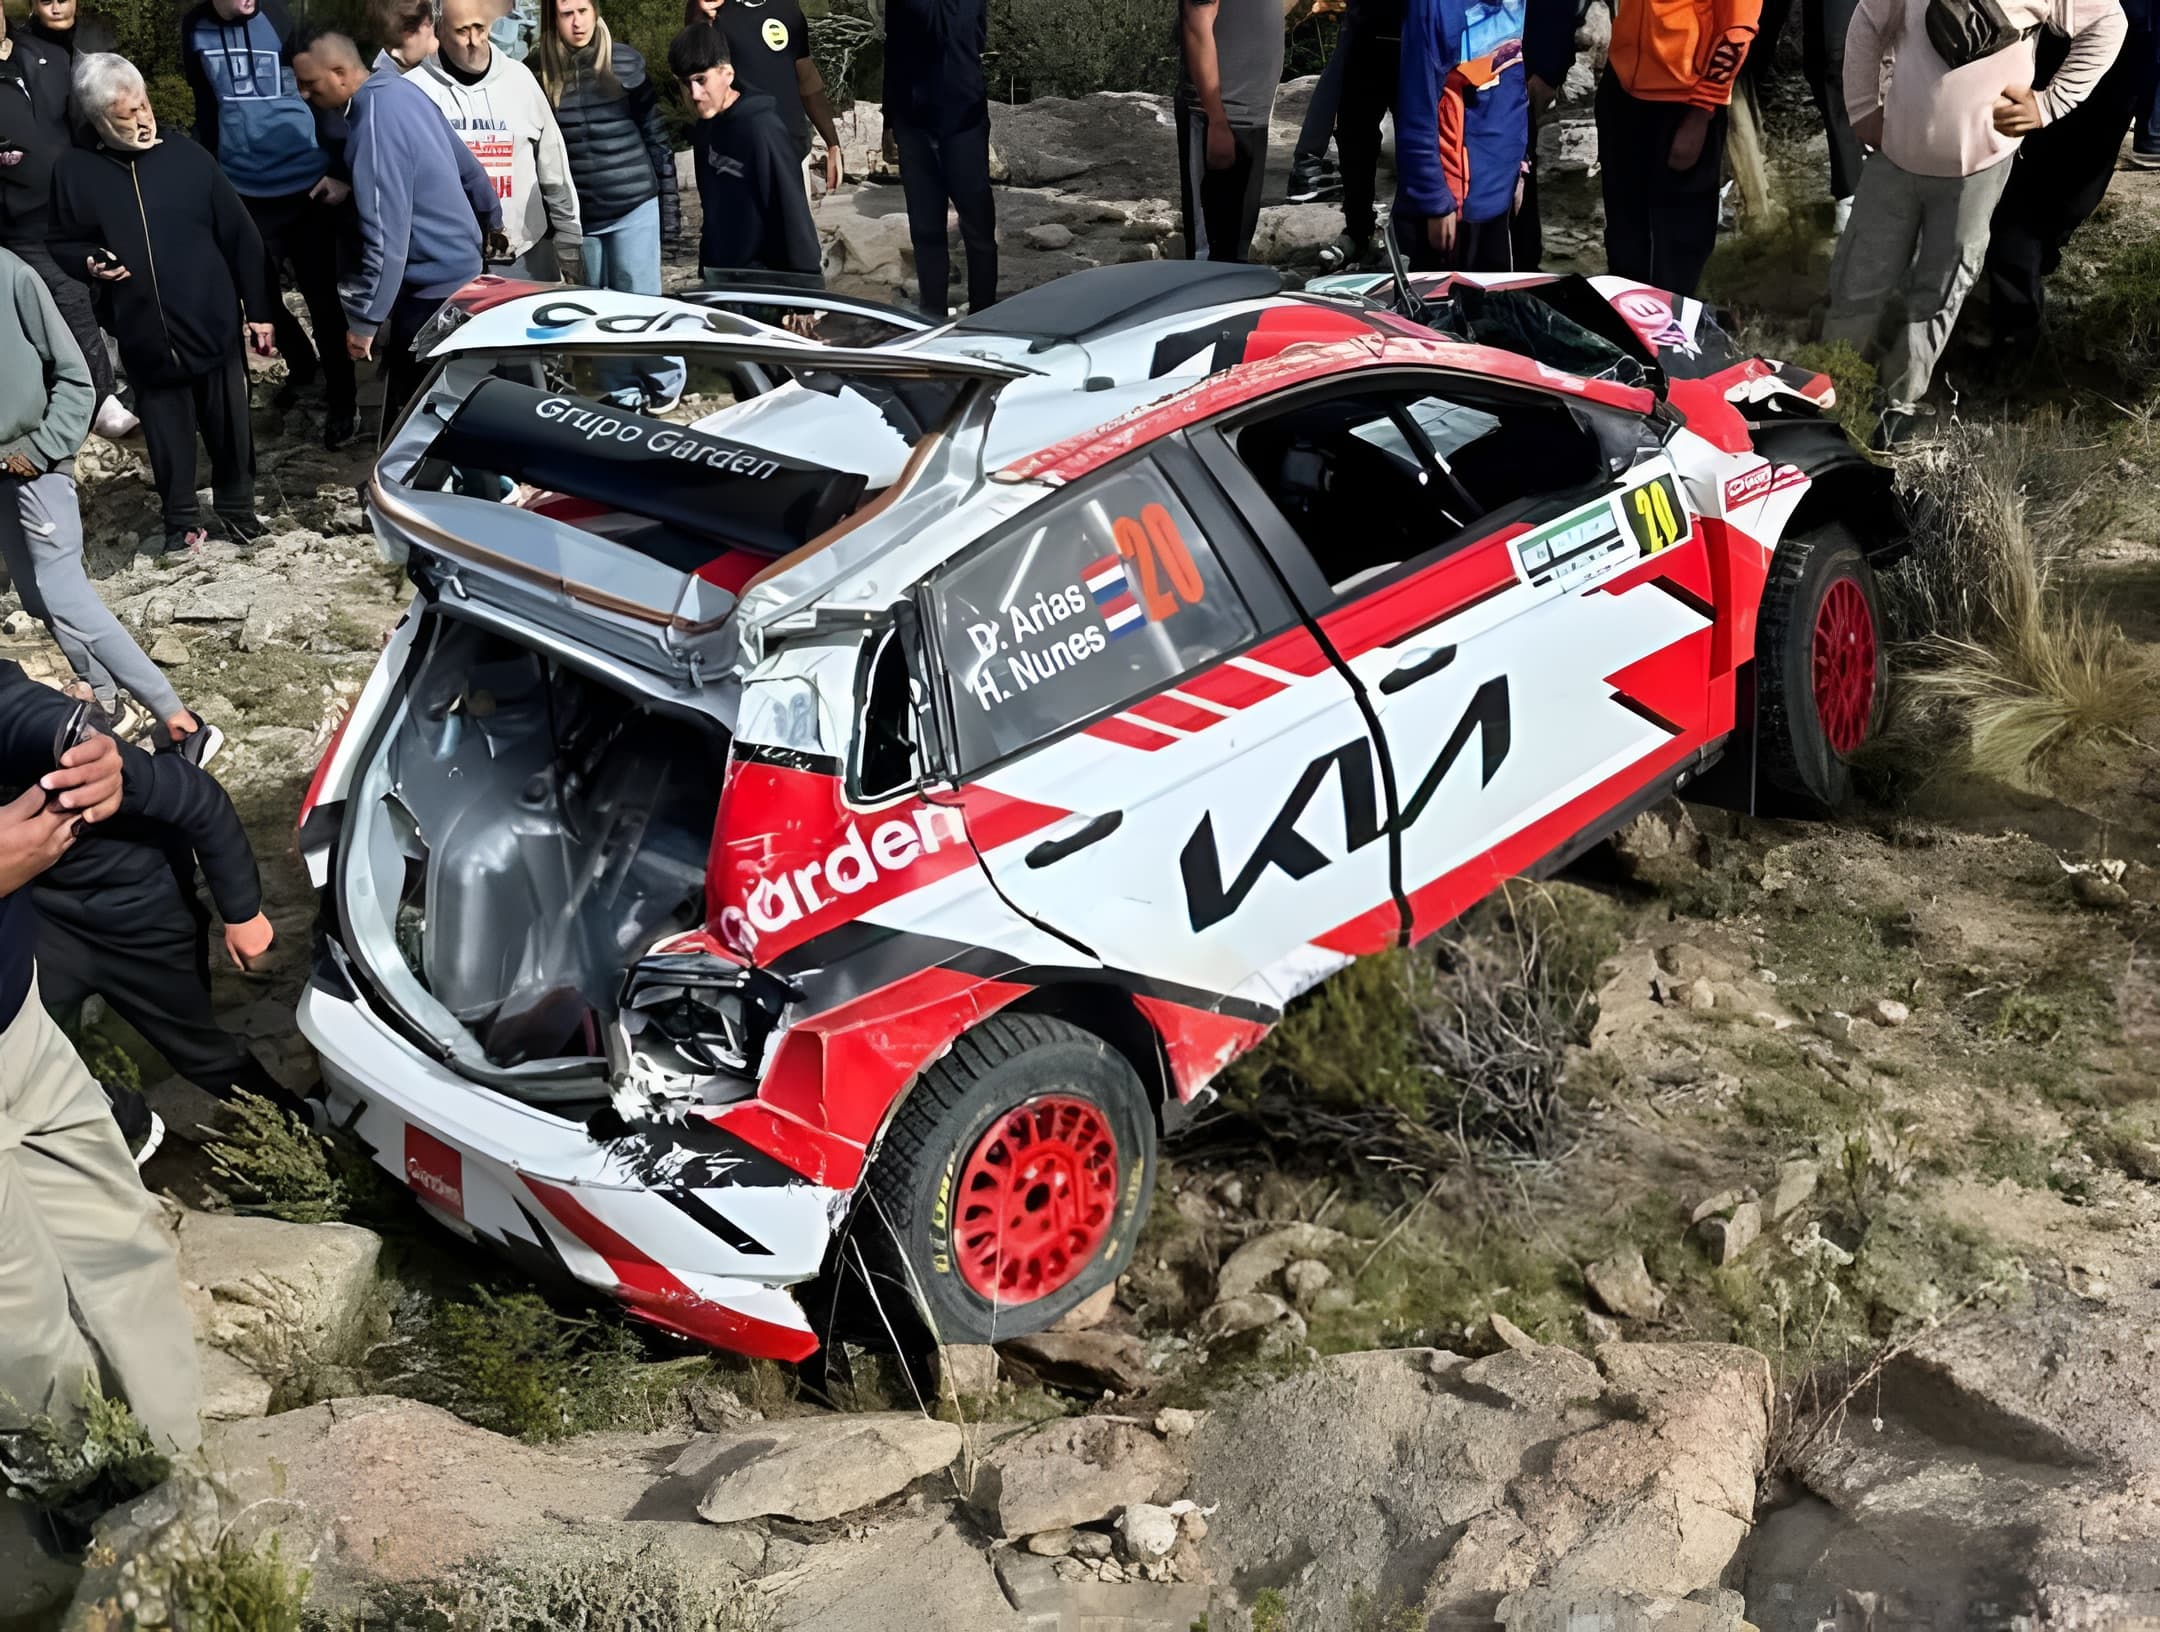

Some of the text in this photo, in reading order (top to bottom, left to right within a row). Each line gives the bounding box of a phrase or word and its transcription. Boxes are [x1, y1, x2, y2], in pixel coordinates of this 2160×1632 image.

[536, 397, 780, 480] Grupo Garden
[1634, 480, 1678, 554] 20
[1113, 502, 1205, 622] 20
[1009, 583, 1087, 644] Arias
[971, 624, 1106, 711] H. Nunes
